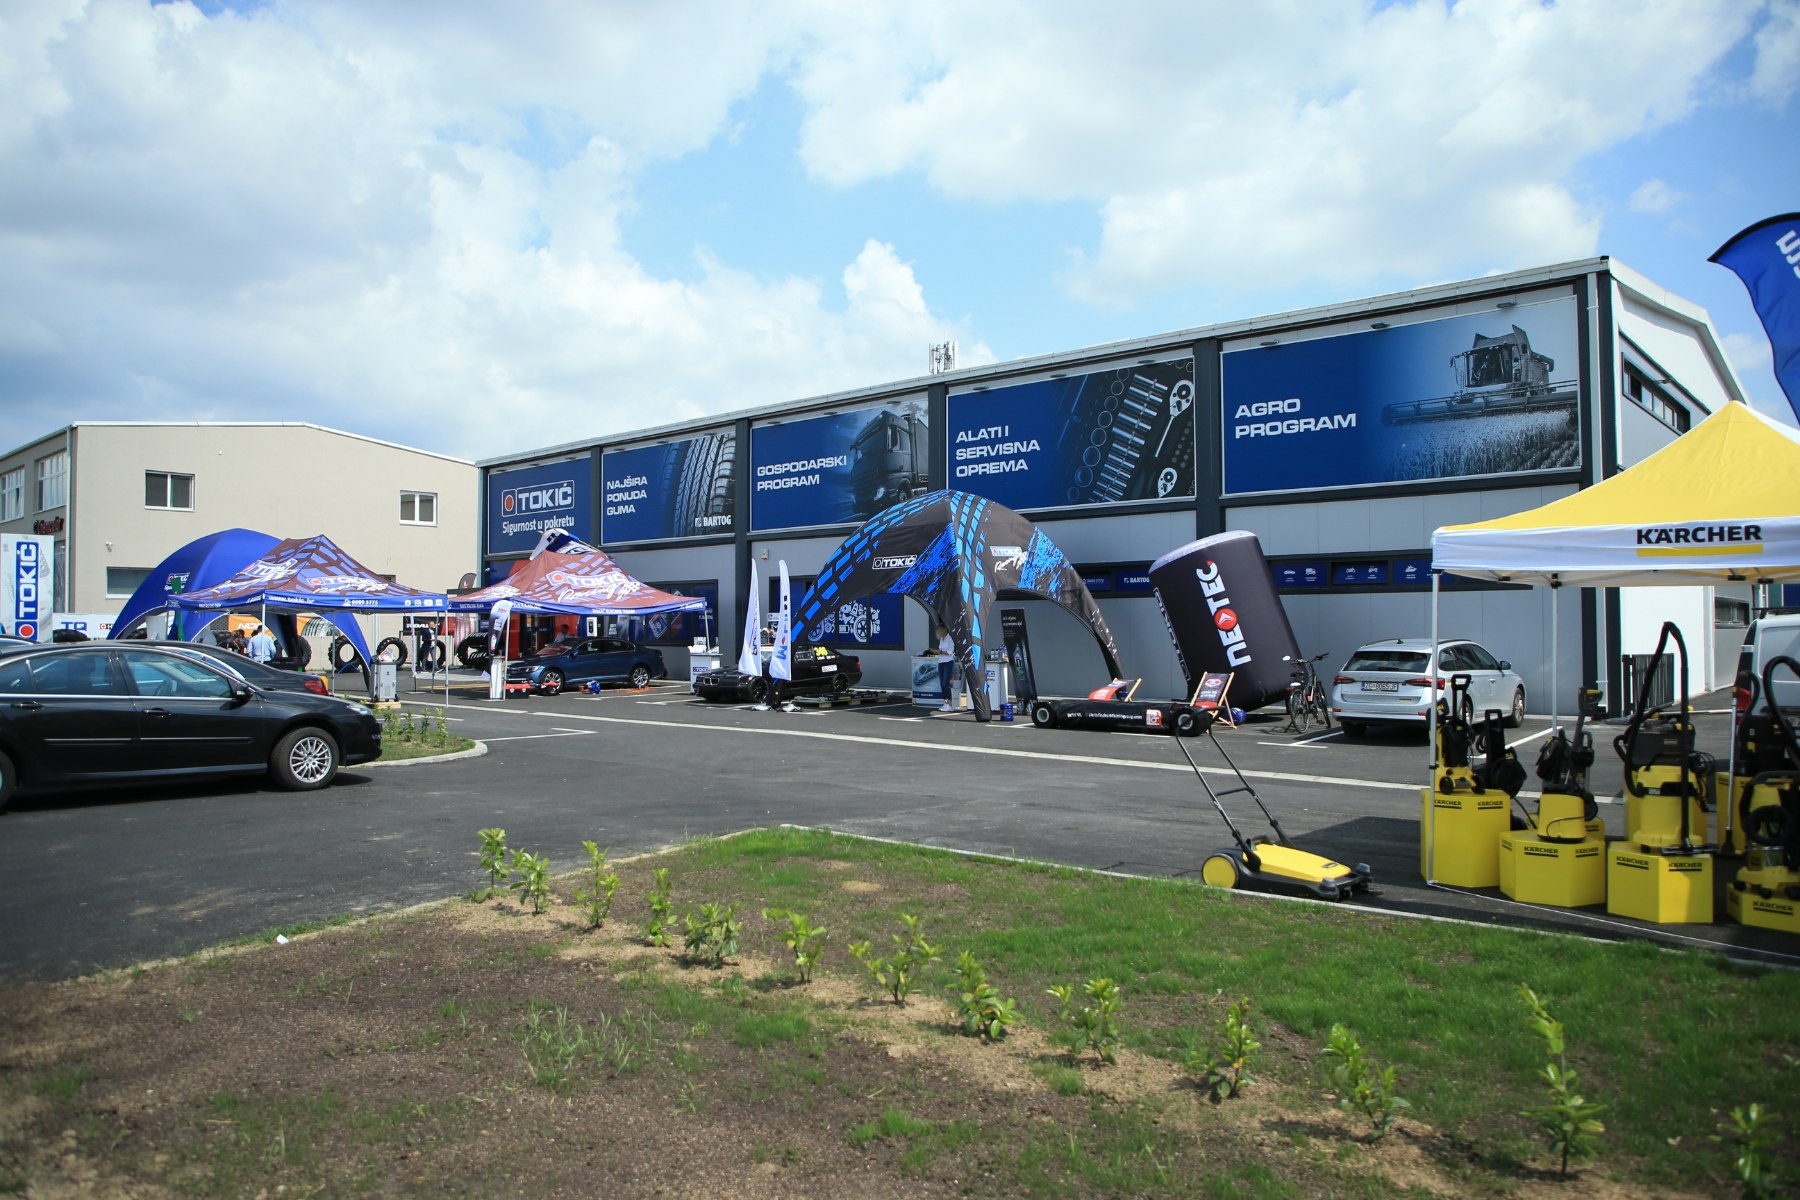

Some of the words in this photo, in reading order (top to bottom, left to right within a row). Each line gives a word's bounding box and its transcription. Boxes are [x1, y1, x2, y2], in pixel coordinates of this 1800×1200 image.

[1234, 398, 1301, 419] AGRO
[956, 426, 1002, 443] ALATI
[1004, 425, 1009, 437] I
[1235, 413, 1357, 439] PROGRAM
[956, 439, 1041, 461] SERVISNA
[757, 455, 847, 477] GOSPODARSKI
[956, 458, 1029, 478] OPREMA
[606, 475, 648, 490] NAJŠIRA
[757, 474, 820, 492] PROGRAM
[517, 482, 573, 511] TOKIĆ
[606, 490, 647, 502] PONUDA
[606, 504, 636, 516] GUMA
[502, 516, 537, 536] Sigurnost
[537, 519, 543, 531] u
[543, 515, 575, 533] pokretu
[703, 514, 732, 527] BARTOG
[1637, 525, 1762, 545] KÄRCHER
[17, 543, 38, 618] TOKIĆ
